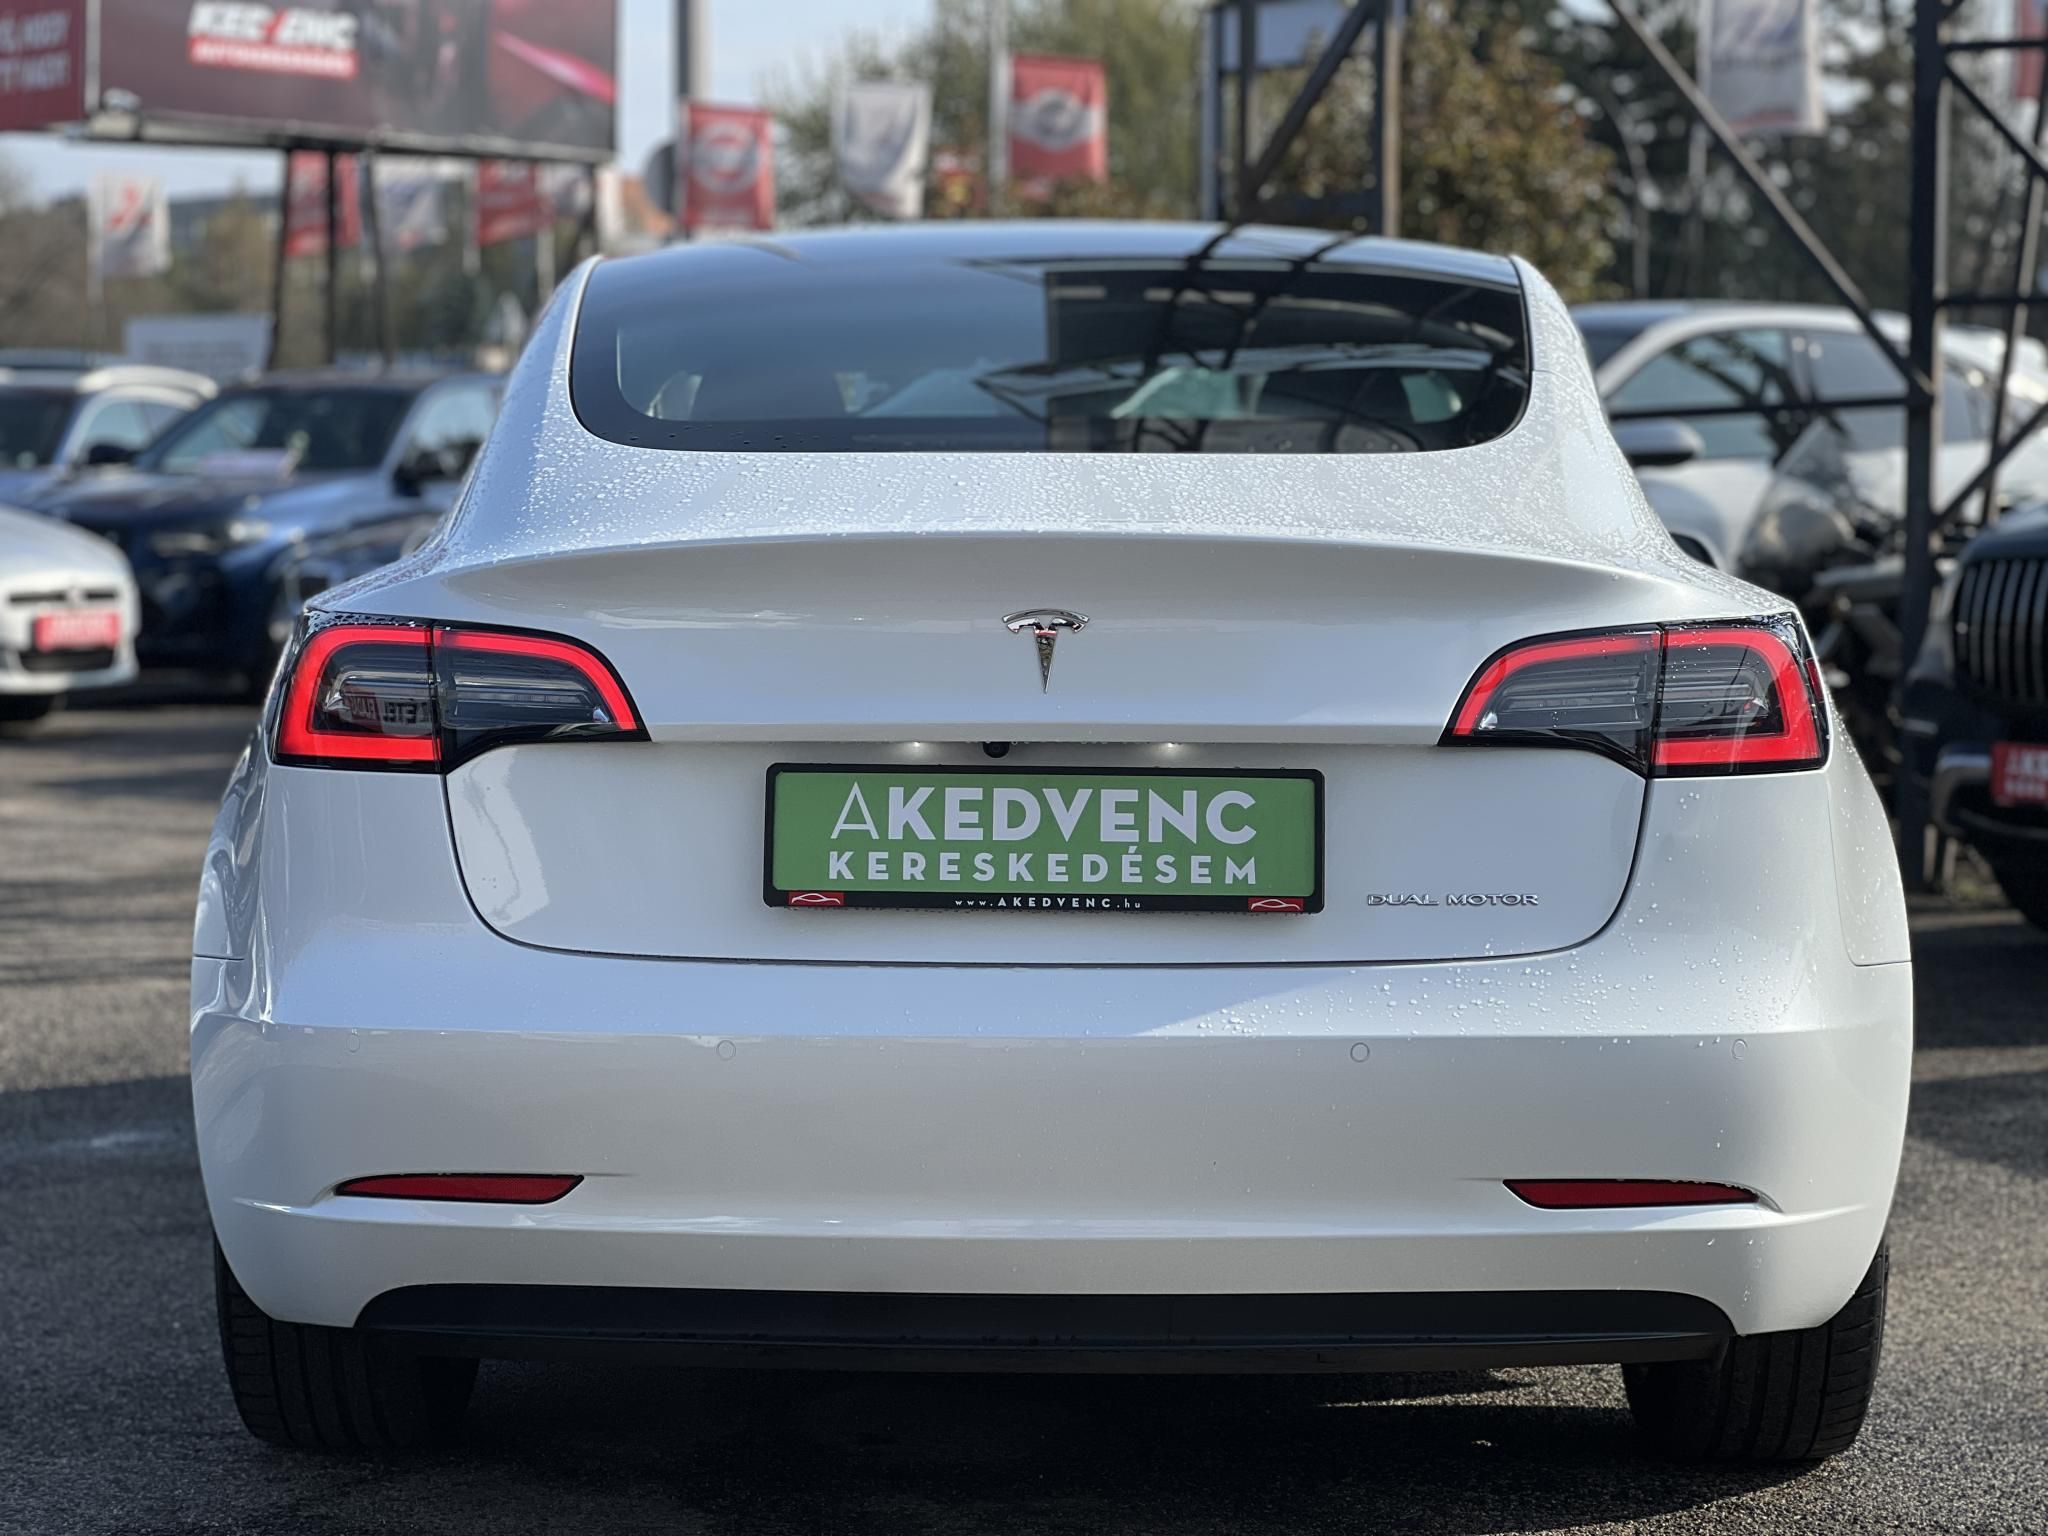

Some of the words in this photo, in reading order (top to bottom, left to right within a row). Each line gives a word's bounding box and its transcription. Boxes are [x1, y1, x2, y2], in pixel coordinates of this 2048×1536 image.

[828, 846, 1256, 885] KERESKEDÉSEM
[955, 896, 1141, 909] www.AKEDVENC.hu
[1367, 893, 1440, 906] DUAL
[1446, 893, 1539, 906] MOTOR
